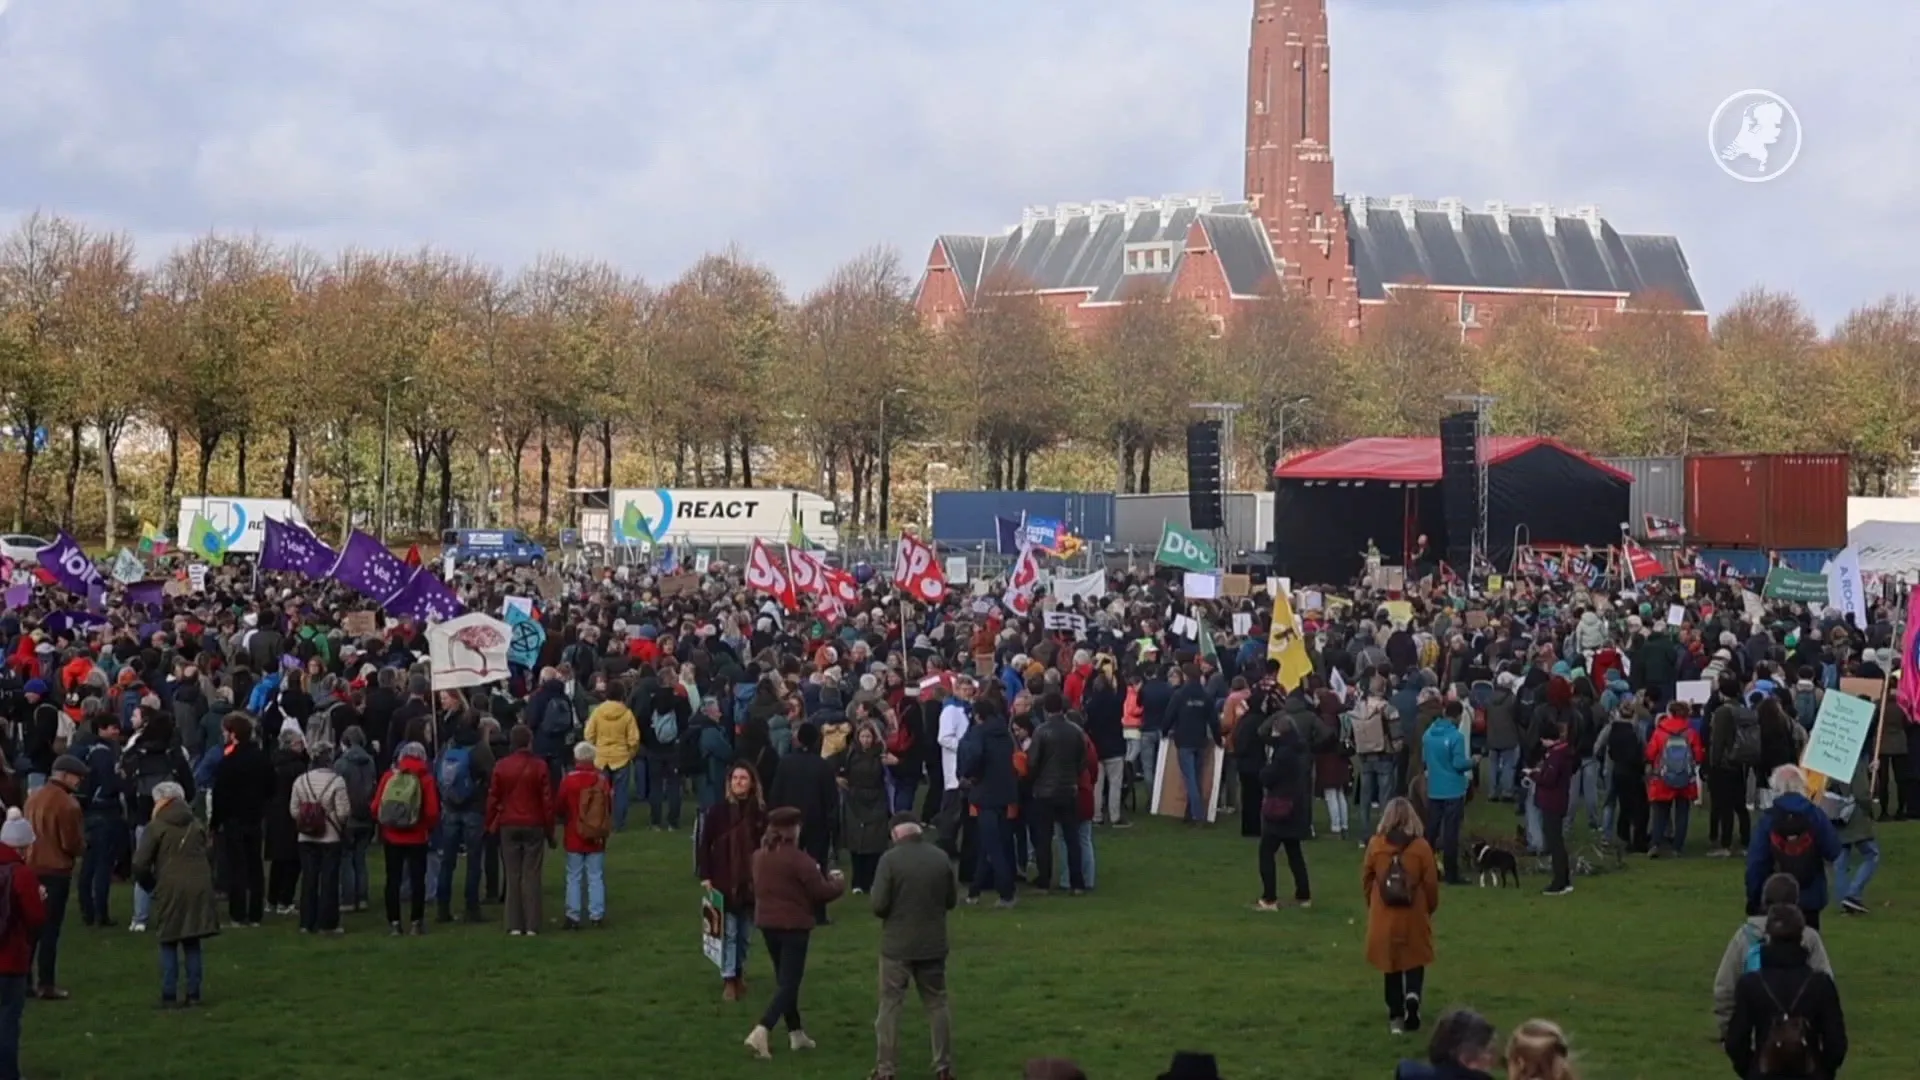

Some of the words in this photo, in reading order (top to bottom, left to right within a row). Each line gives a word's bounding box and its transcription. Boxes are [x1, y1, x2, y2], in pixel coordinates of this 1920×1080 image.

[677, 501, 759, 518] REACT
[896, 538, 931, 588] SP
[1842, 580, 1854, 612] ROC
